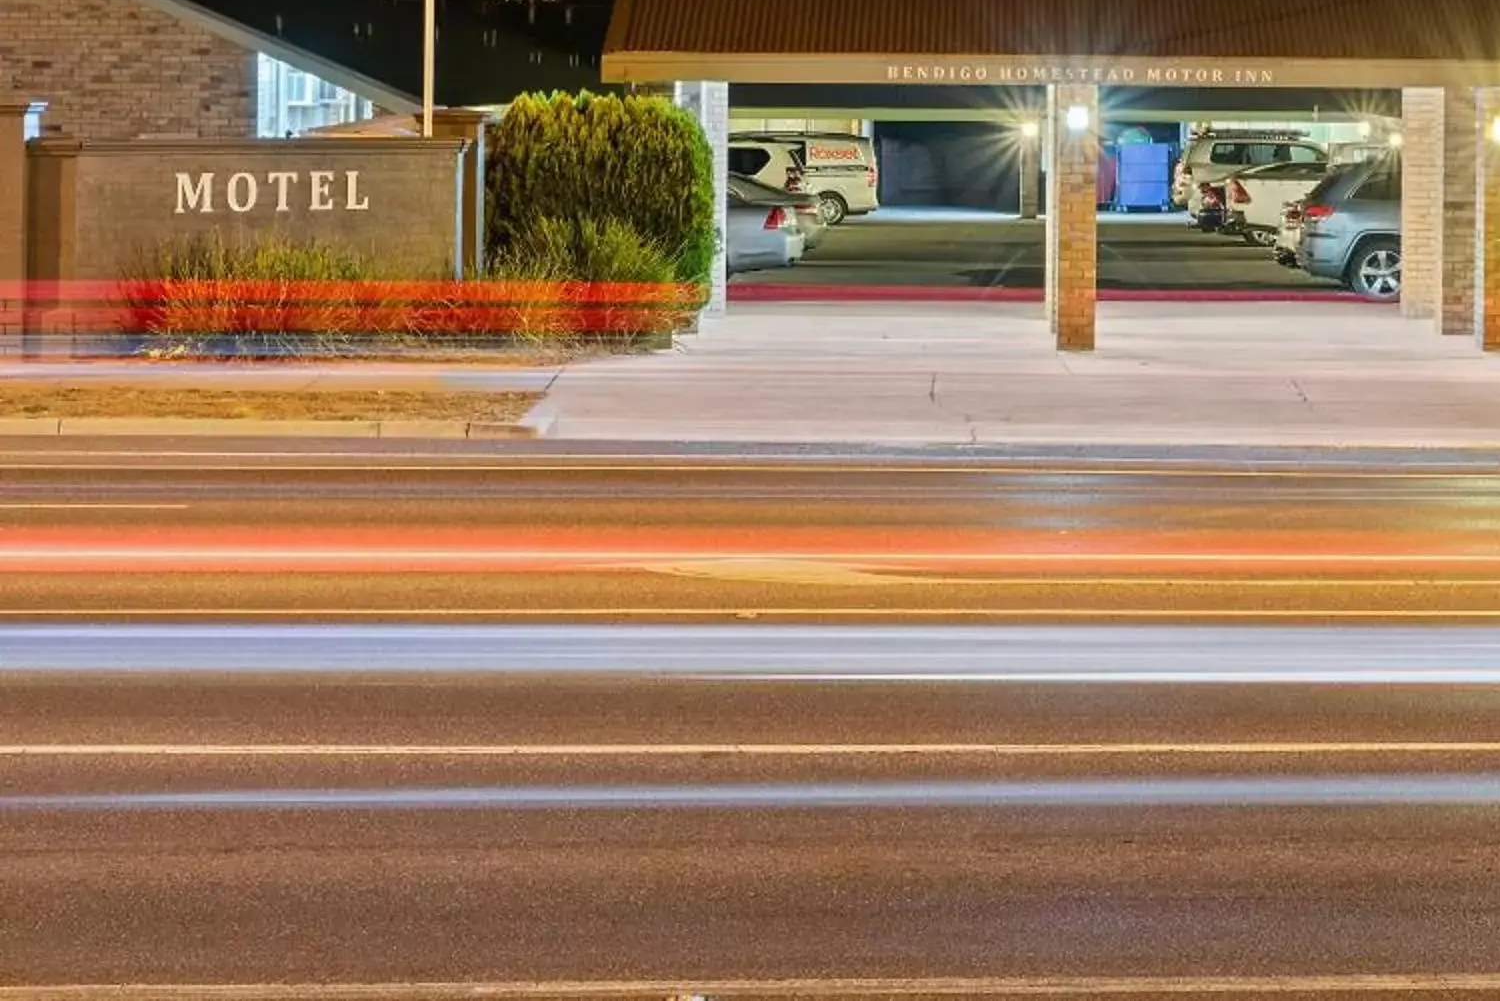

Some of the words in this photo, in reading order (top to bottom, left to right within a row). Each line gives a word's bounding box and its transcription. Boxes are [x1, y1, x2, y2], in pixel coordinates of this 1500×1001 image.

[887, 65, 988, 81] BENDIGO
[999, 66, 1135, 82] HOMESTEAD
[1147, 68, 1224, 82] MOTOR
[1234, 69, 1273, 83] INN
[174, 170, 370, 214] MOTEL
